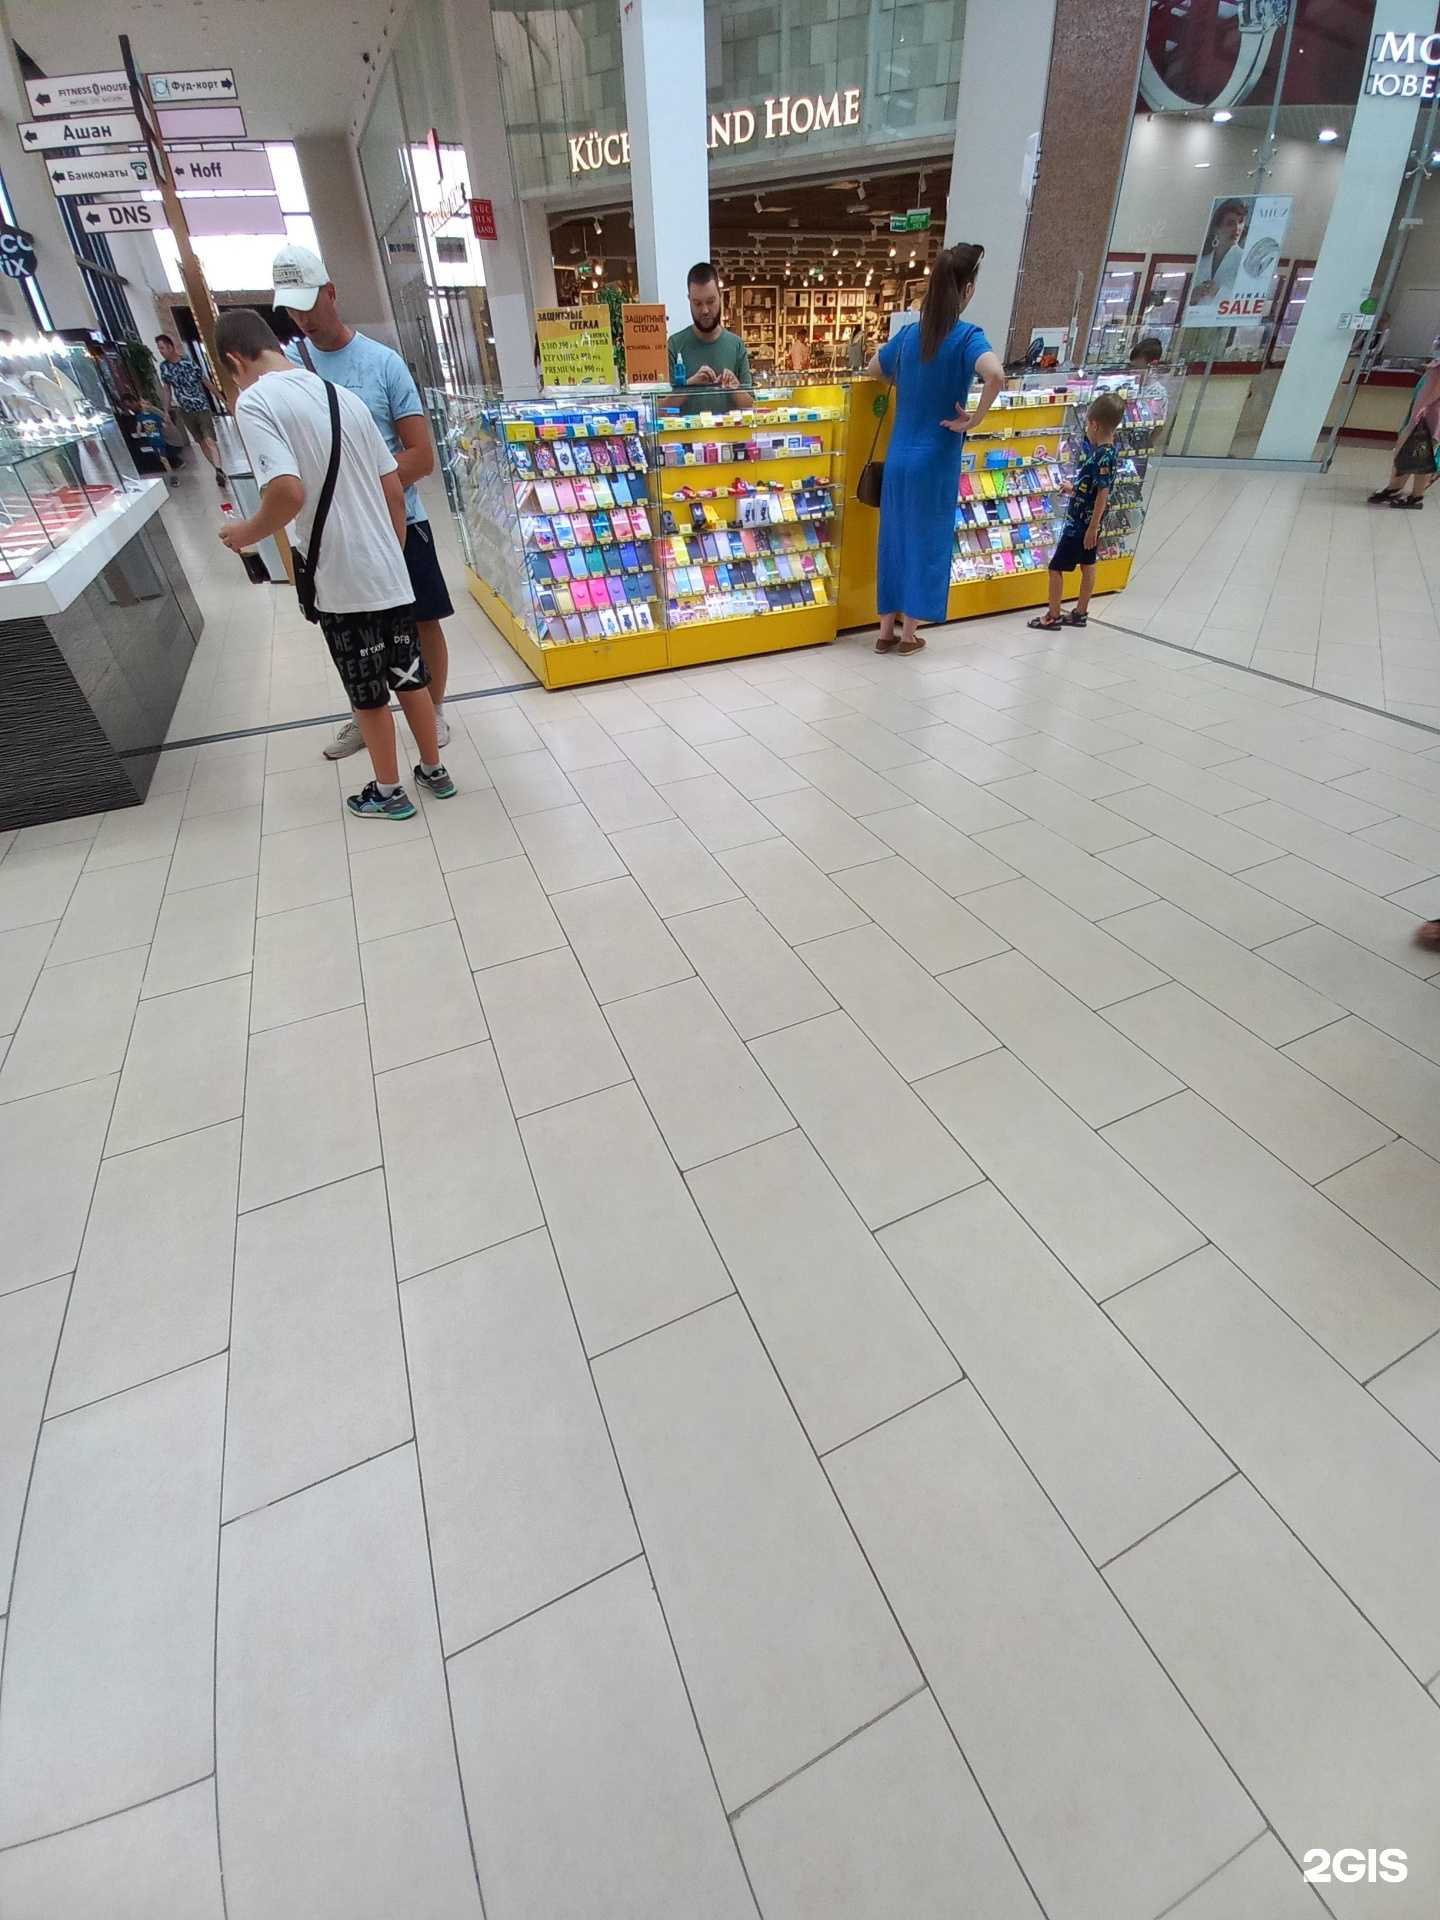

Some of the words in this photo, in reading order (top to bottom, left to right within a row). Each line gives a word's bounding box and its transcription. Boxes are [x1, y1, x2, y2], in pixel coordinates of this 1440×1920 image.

[57, 85, 92, 97] FITNESS
[99, 82, 129, 93] HOUSE
[171, 80, 218, 92] Фуд-корт
[1370, 74, 1440, 98] ЮВЕ
[764, 88, 860, 139] HOME
[63, 124, 112, 141] Ашан
[67, 169, 129, 182] Банкоматы
[189, 162, 223, 178] Hoff
[108, 205, 151, 225] DNS
[1217, 299, 1265, 315] SALE
[569, 319, 599, 330] СТЕКЛА
[624, 314, 665, 324] ЗАЩИТНЫЕ
[632, 324, 660, 333] СТЕКЛА
[632, 369, 658, 383] pixel
